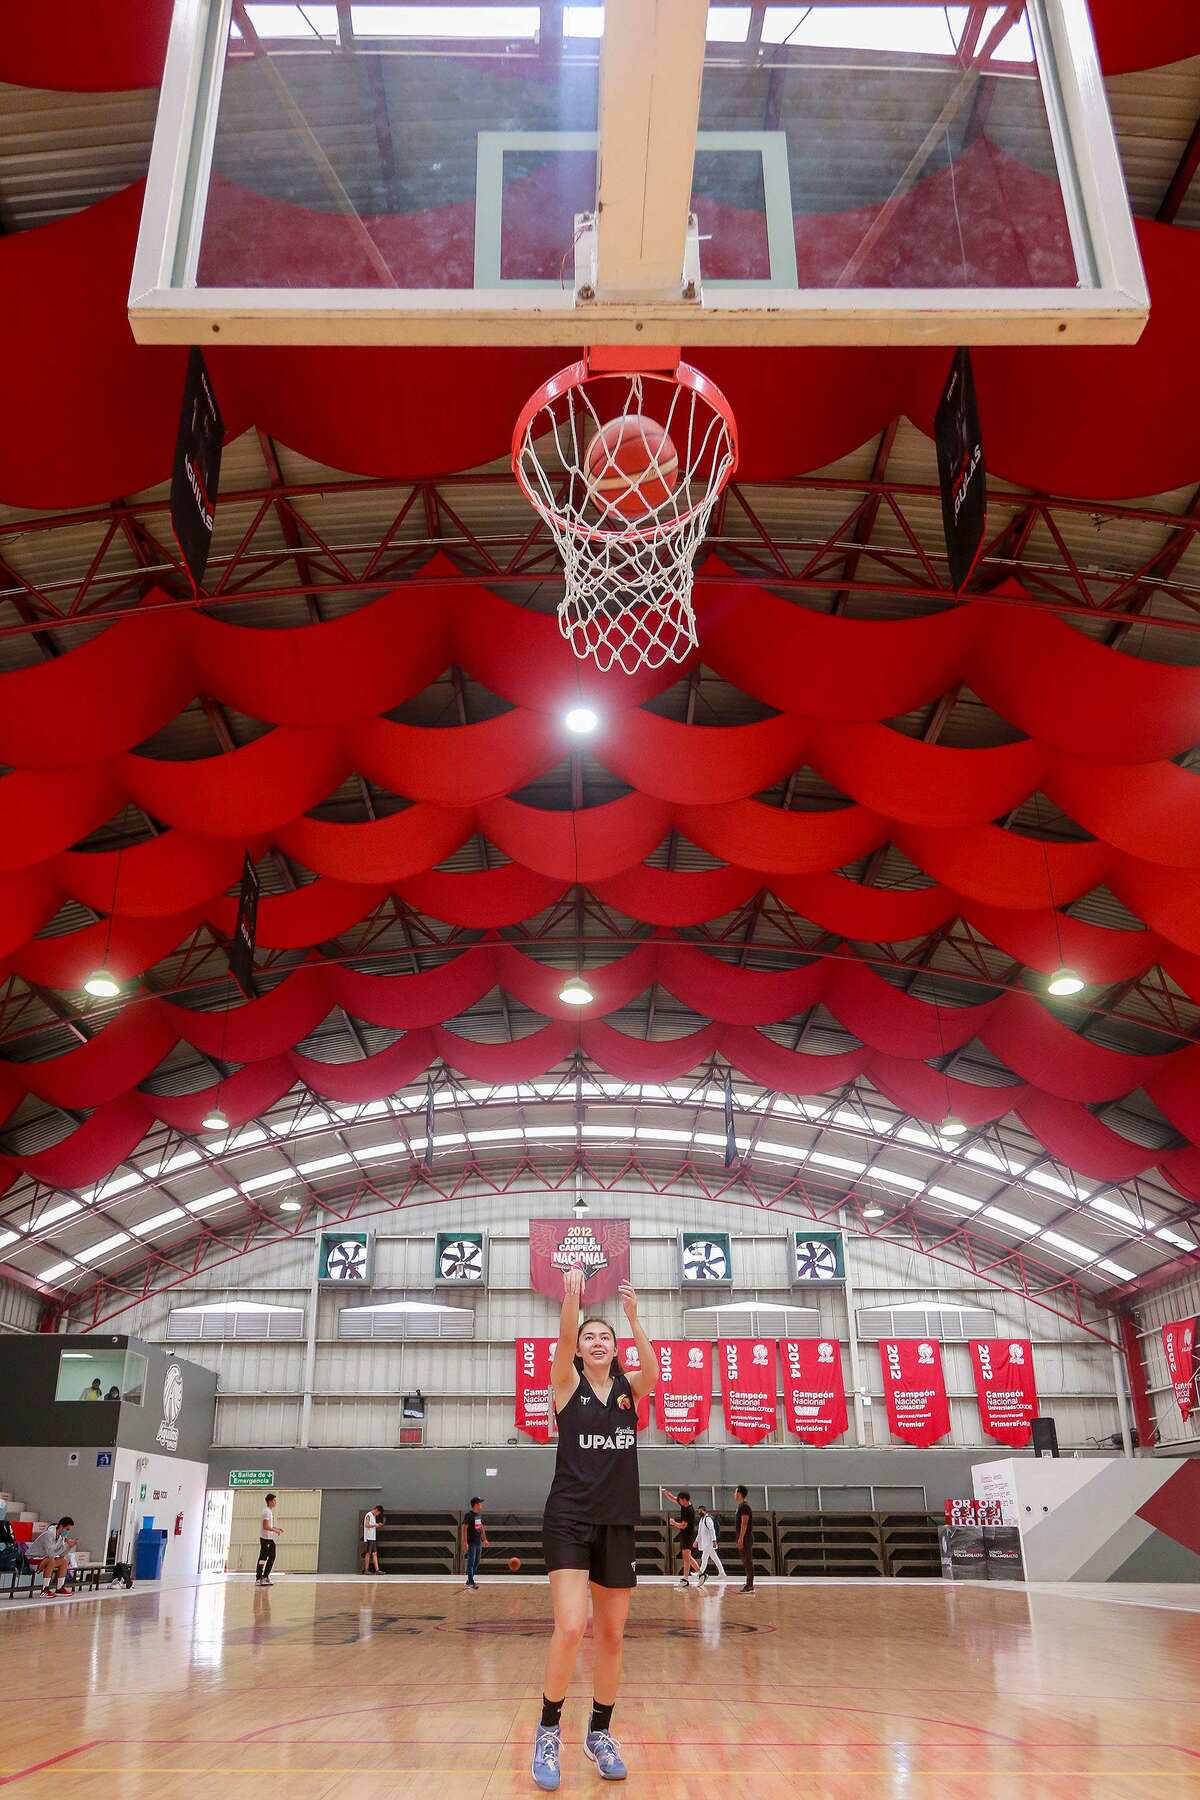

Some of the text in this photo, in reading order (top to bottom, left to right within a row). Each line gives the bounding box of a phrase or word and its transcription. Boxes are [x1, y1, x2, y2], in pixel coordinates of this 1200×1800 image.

[567, 1226, 592, 1236] 2012
[564, 1237, 596, 1245] DOBLE
[553, 1251, 607, 1265] NACIONAL
[523, 1343, 535, 1377] 2017
[661, 1347, 672, 1382] 2016
[726, 1344, 738, 1380] 2015
[787, 1343, 801, 1379] 2014
[886, 1344, 902, 1380] 2012
[978, 1344, 993, 1380] 2012
[523, 1388, 548, 1397] Camp
[664, 1392, 703, 1402] Campeón
[729, 1390, 768, 1400] Campeón
[793, 1390, 834, 1400] Campeón
[894, 1389, 936, 1399] Campeón
[664, 1400, 695, 1408] Nacional
[729, 1397, 761, 1406] Nacional
[793, 1397, 826, 1406] Nacional
[894, 1397, 928, 1405] Nacional
[986, 1397, 1018, 1405] Nacional
[579, 1434, 635, 1449] UPAEP
